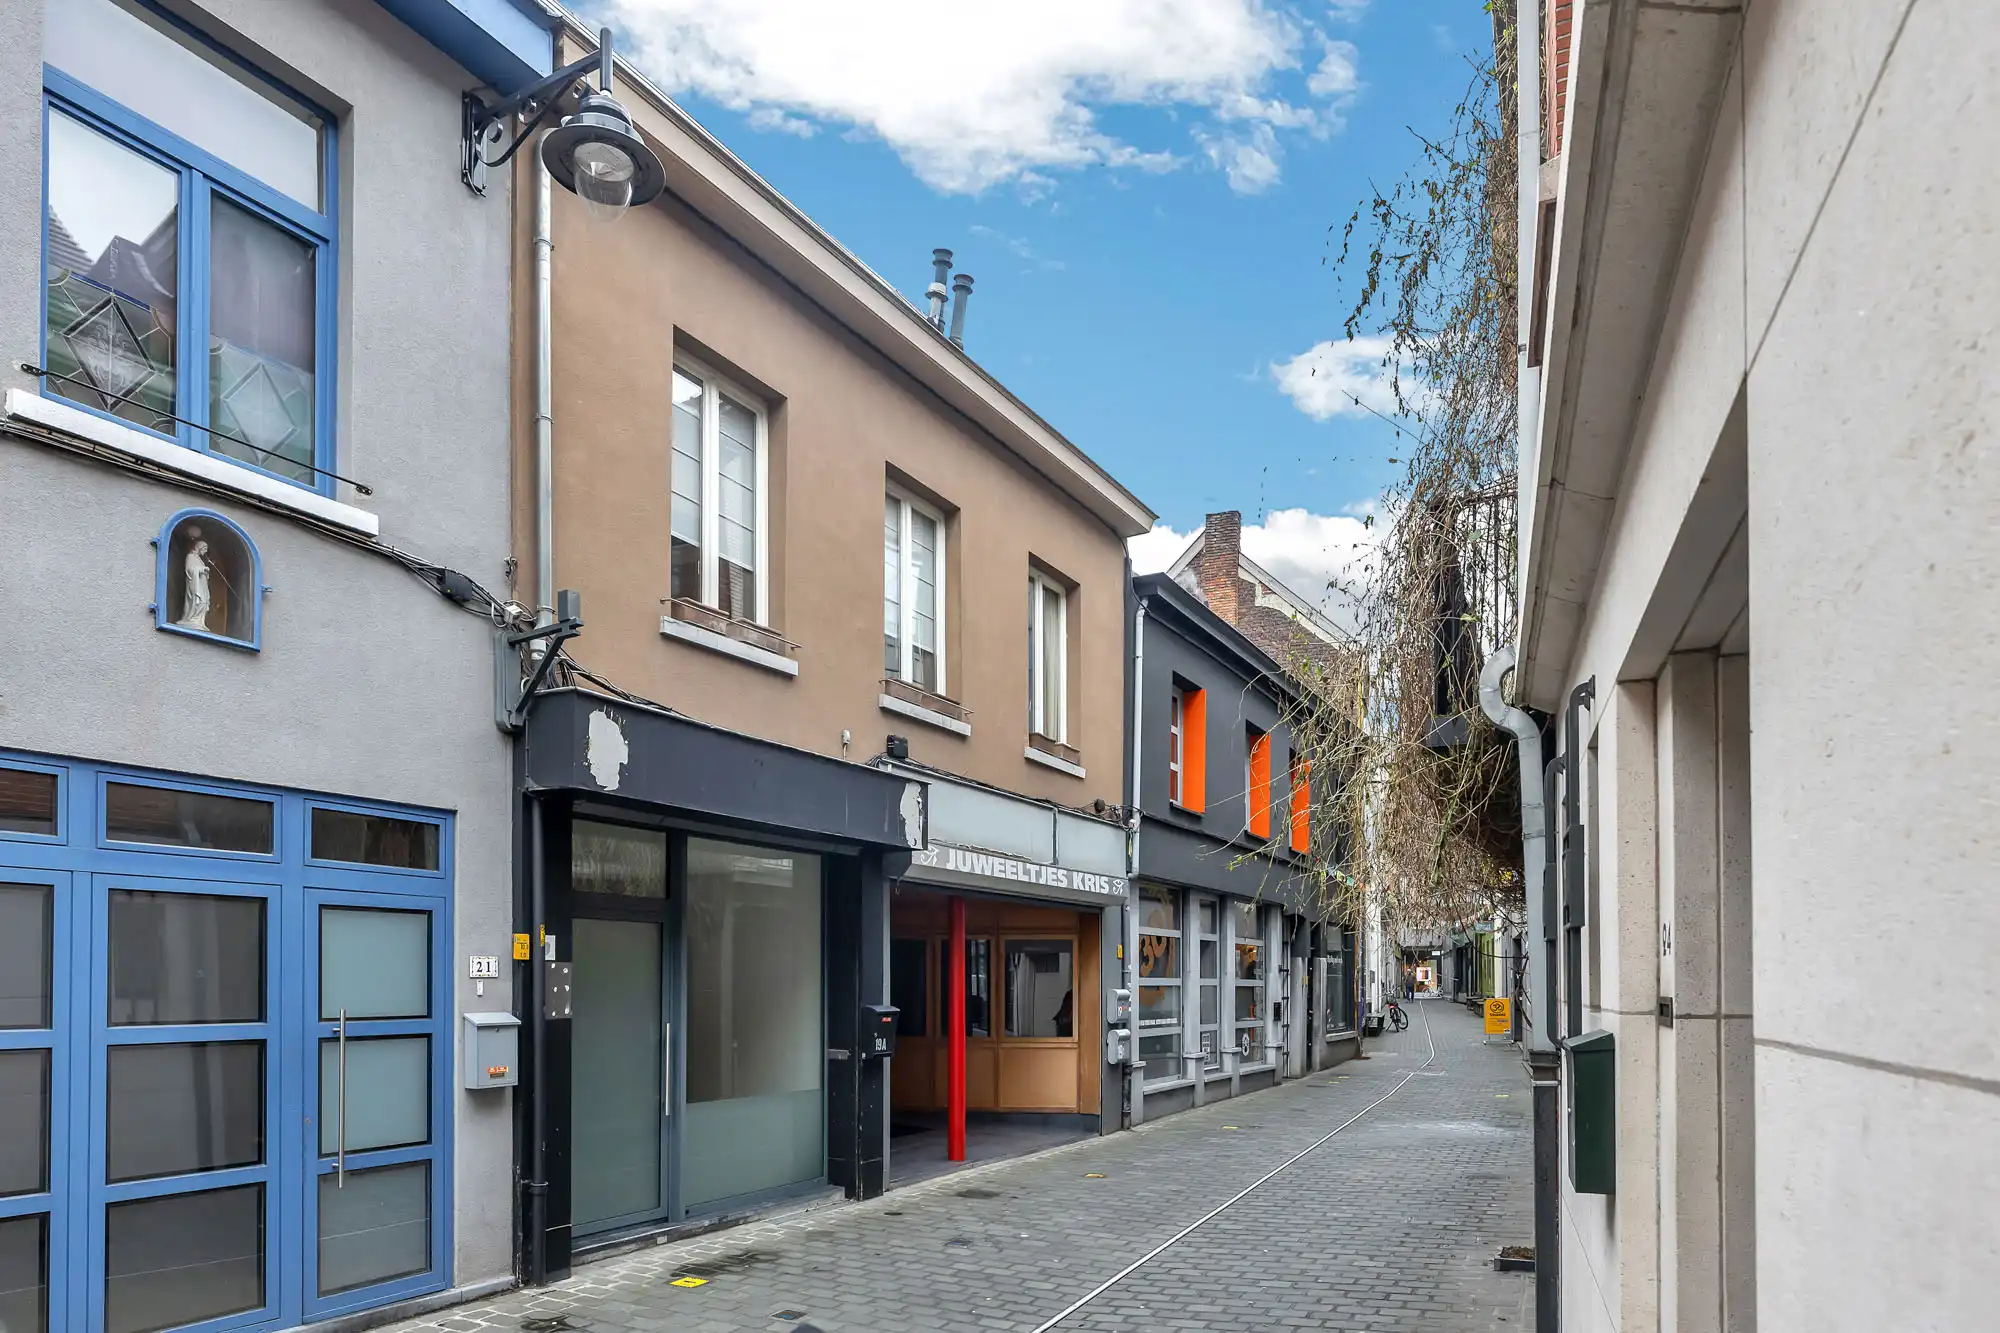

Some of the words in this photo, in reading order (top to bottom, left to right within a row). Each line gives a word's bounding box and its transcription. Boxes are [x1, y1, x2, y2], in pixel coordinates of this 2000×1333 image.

[945, 848, 1068, 888] JUWEELTJES
[1072, 872, 1110, 894] KRIS
[476, 961, 491, 973] 21
[875, 1037, 887, 1051] 19A
